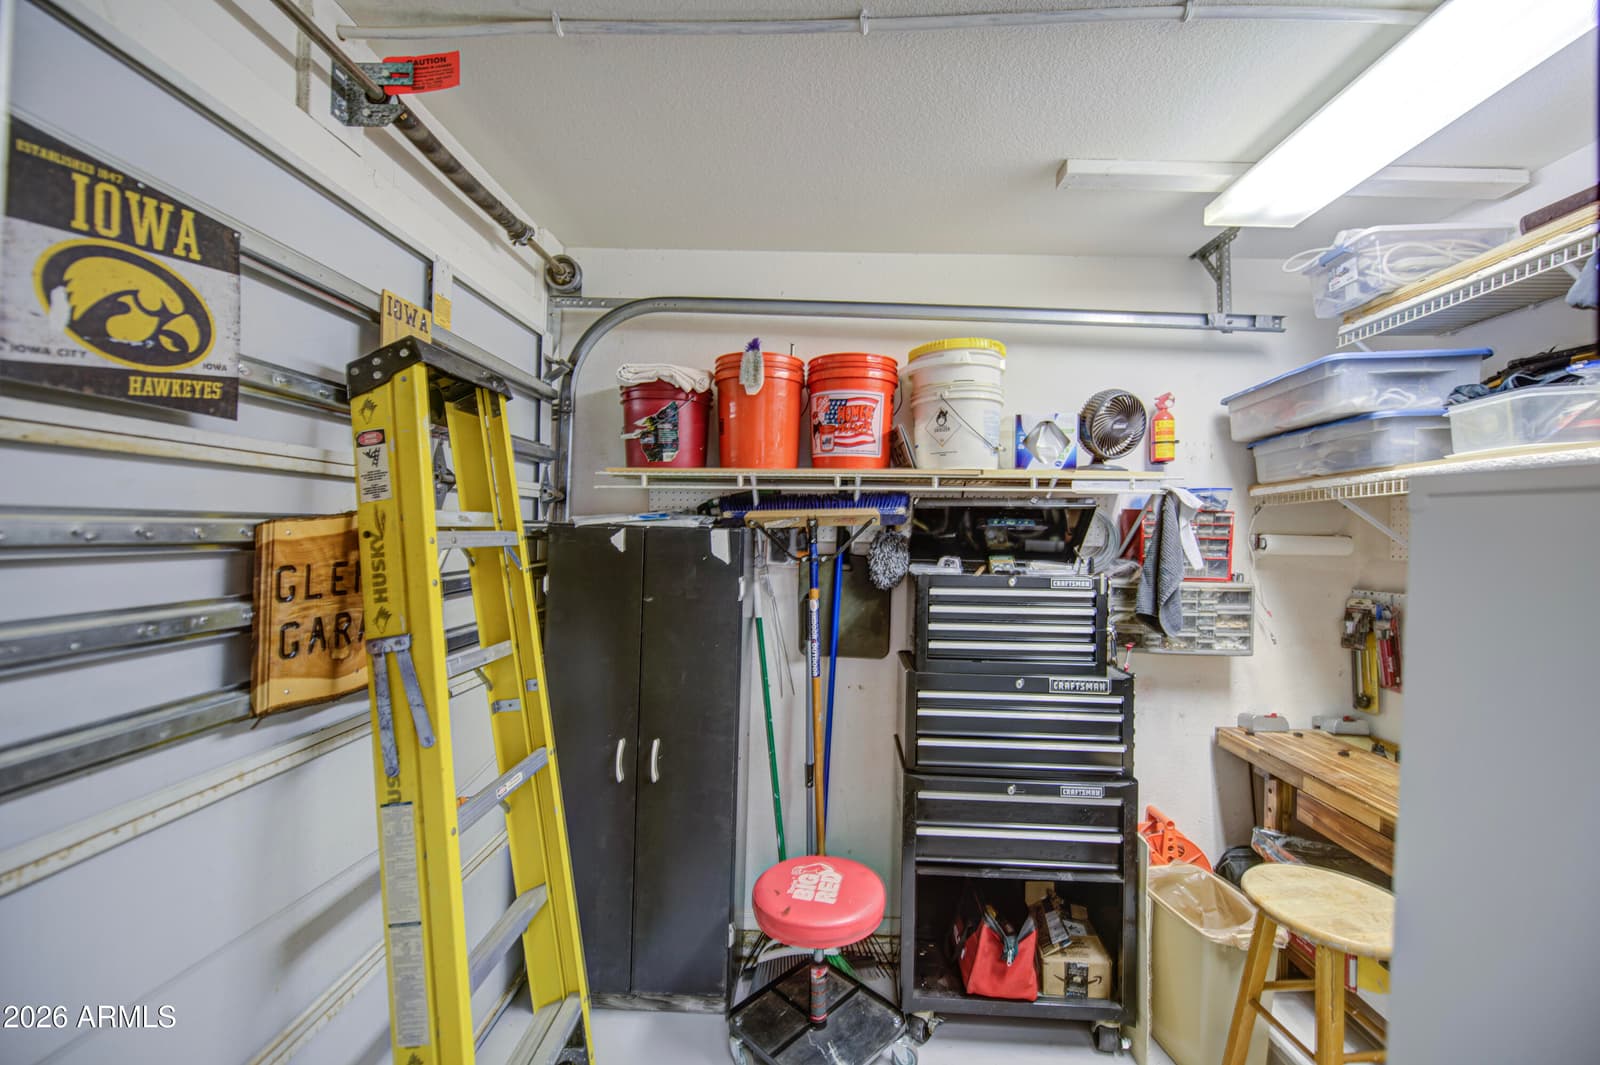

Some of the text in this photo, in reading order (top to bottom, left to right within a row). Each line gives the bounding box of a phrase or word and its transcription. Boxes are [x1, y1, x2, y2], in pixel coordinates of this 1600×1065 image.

[70, 172, 201, 261] IOWA
[387, 295, 429, 334] IOWA
[11, 344, 87, 359] IOWA CITY
[202, 362, 228, 372] IOWA
[128, 376, 223, 400] HAWKEYES
[370, 503, 388, 604] HUSKY
[1053, 680, 1106, 692] CRAFTSMAN
[791, 872, 820, 902] BIG
[814, 872, 843, 905] RED
